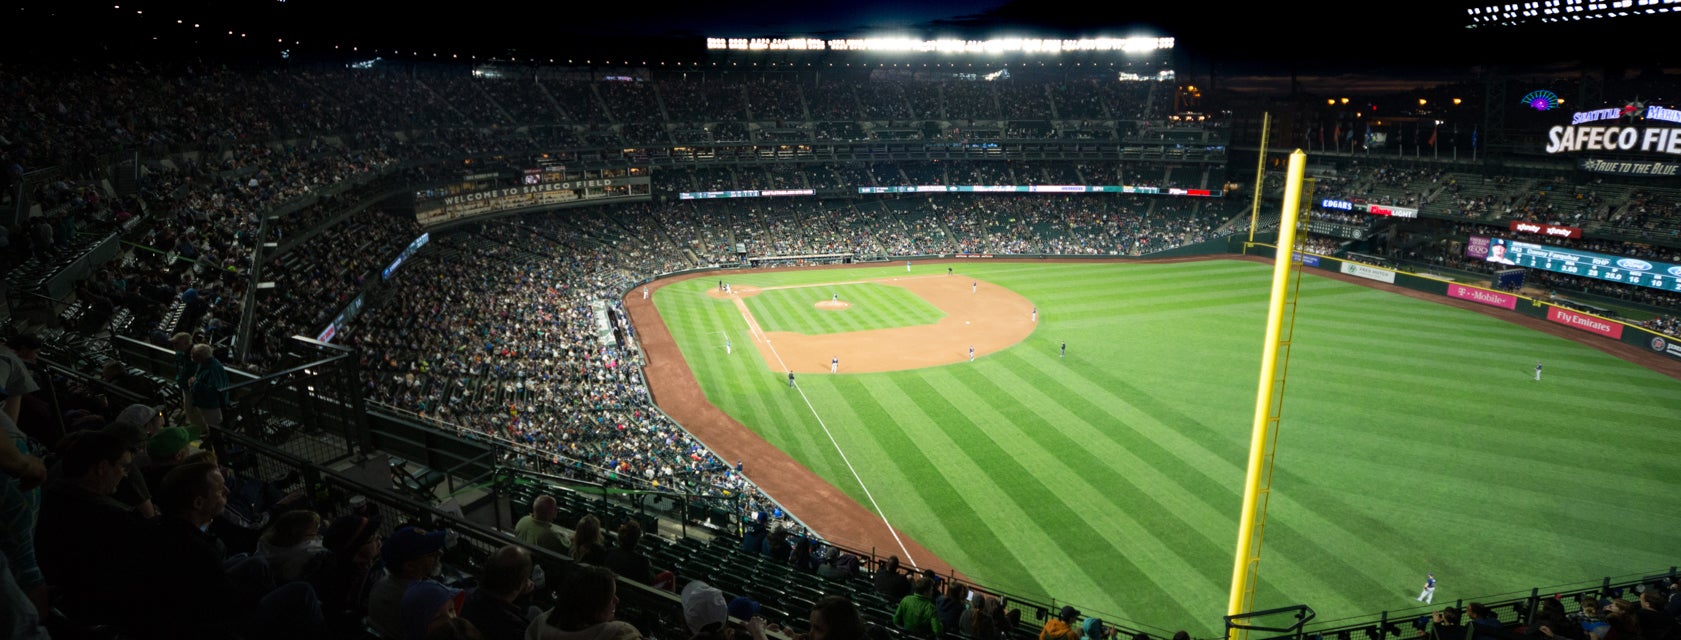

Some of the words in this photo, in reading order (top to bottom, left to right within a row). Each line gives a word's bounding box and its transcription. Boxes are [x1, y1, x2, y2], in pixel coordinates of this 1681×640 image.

[1572, 108, 1621, 125] SEATTLE
[1546, 125, 1638, 154] SAFECO
[1594, 160, 1618, 172] TRUE
[1620, 163, 1631, 173] TO
[1632, 163, 1649, 174] THE
[1650, 162, 1679, 175] BLUE
[444, 190, 498, 205] WELCOME
[503, 186, 518, 196] TO
[523, 182, 570, 193] SAFECO
[576, 178, 612, 188] FIELD
[1392, 209, 1412, 218] LIGHT
[1517, 223, 1541, 233] xfinity
[1546, 227, 1572, 237] xfinity
[1605, 272, 1622, 280] 25.0
[1557, 311, 1571, 324] Fly
[1572, 315, 1611, 333] Emirates
